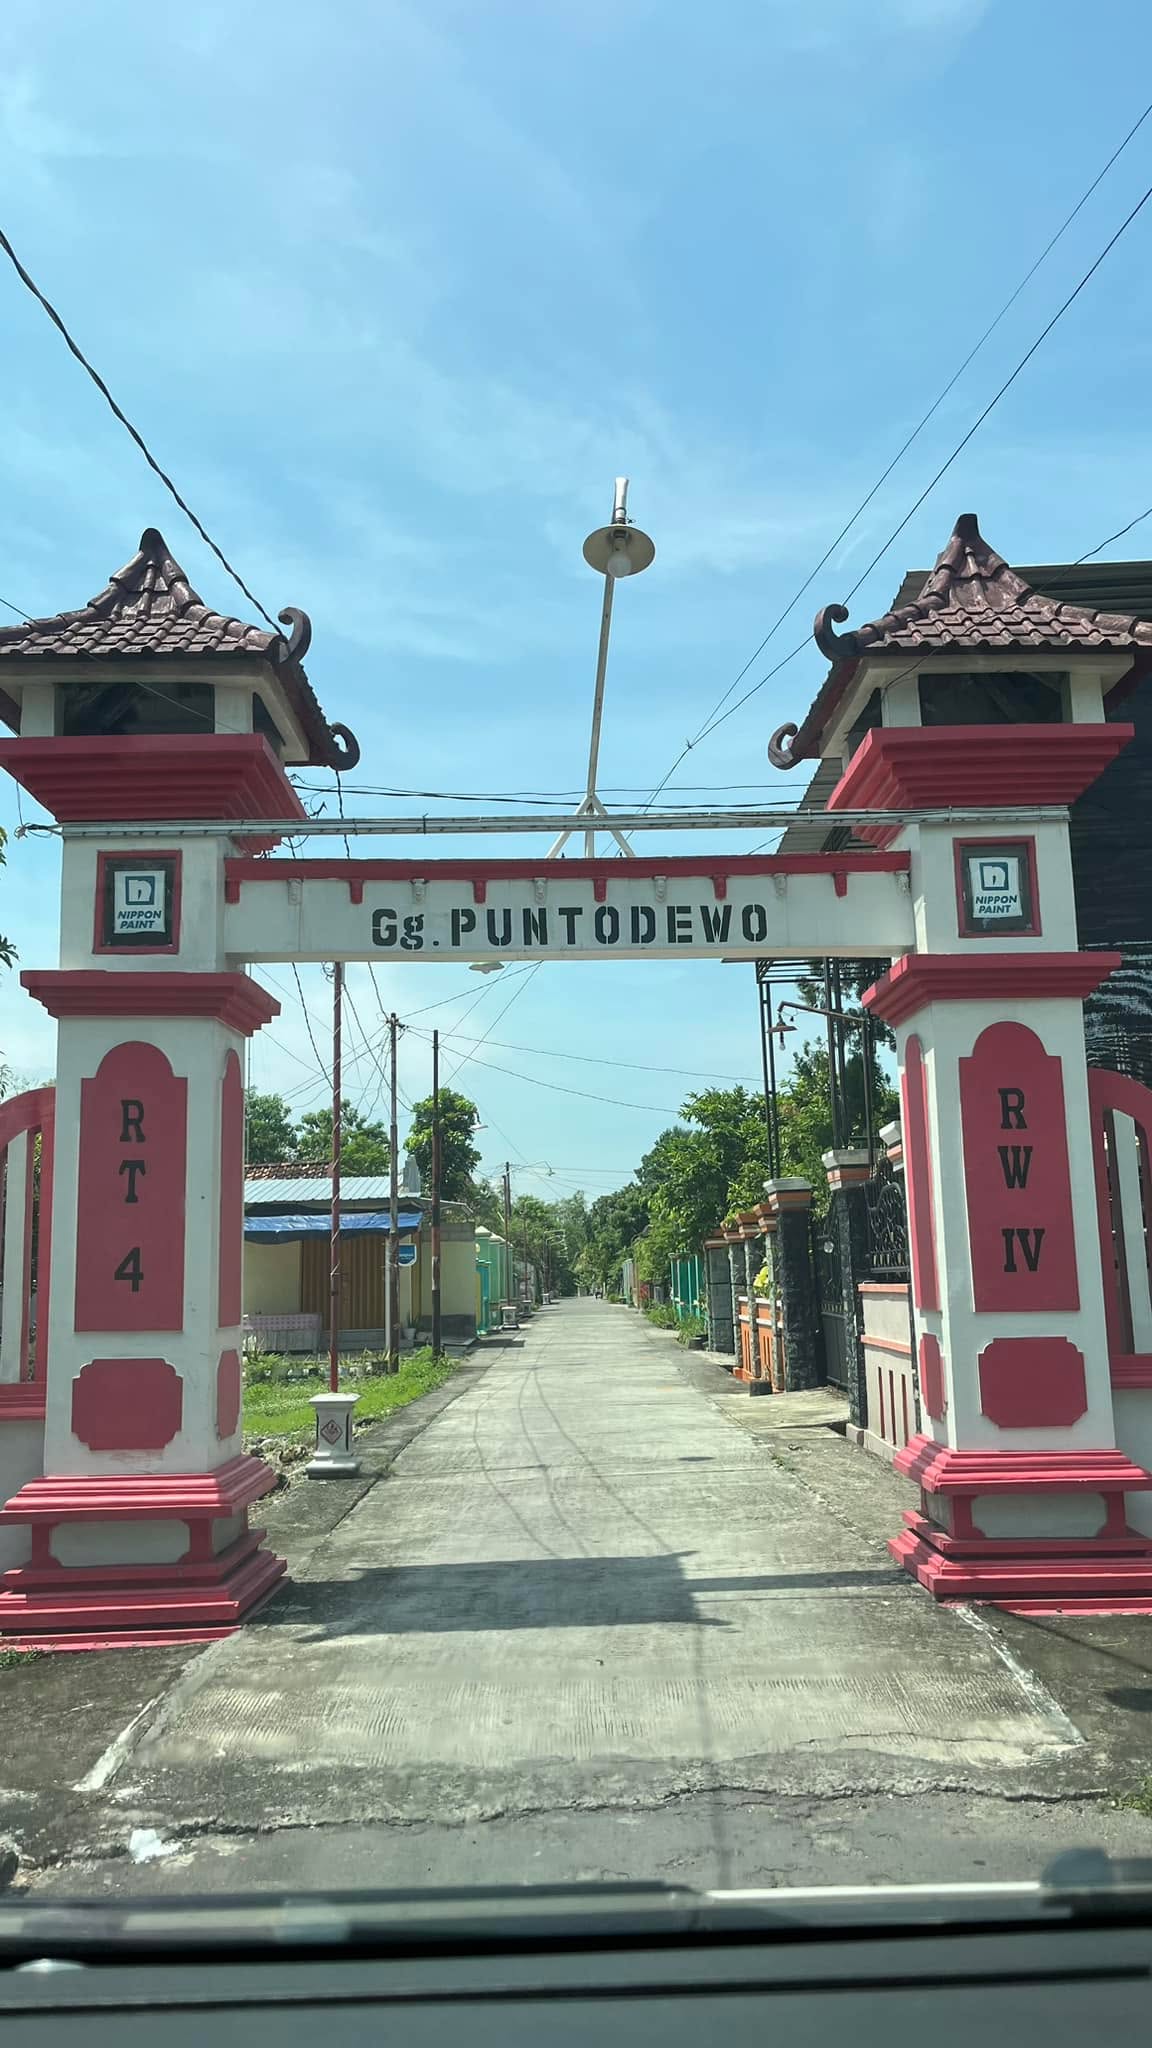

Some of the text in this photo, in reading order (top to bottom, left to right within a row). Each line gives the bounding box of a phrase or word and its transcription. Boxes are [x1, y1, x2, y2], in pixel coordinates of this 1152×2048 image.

[975, 895, 1018, 904] NIPPON
[978, 905, 1011, 914] PAINT
[117, 910, 162, 920] NIPPON
[120, 920, 155, 929] PAINT
[1001, 1227, 1046, 1273] IV
[114, 1246, 145, 1293] 4
